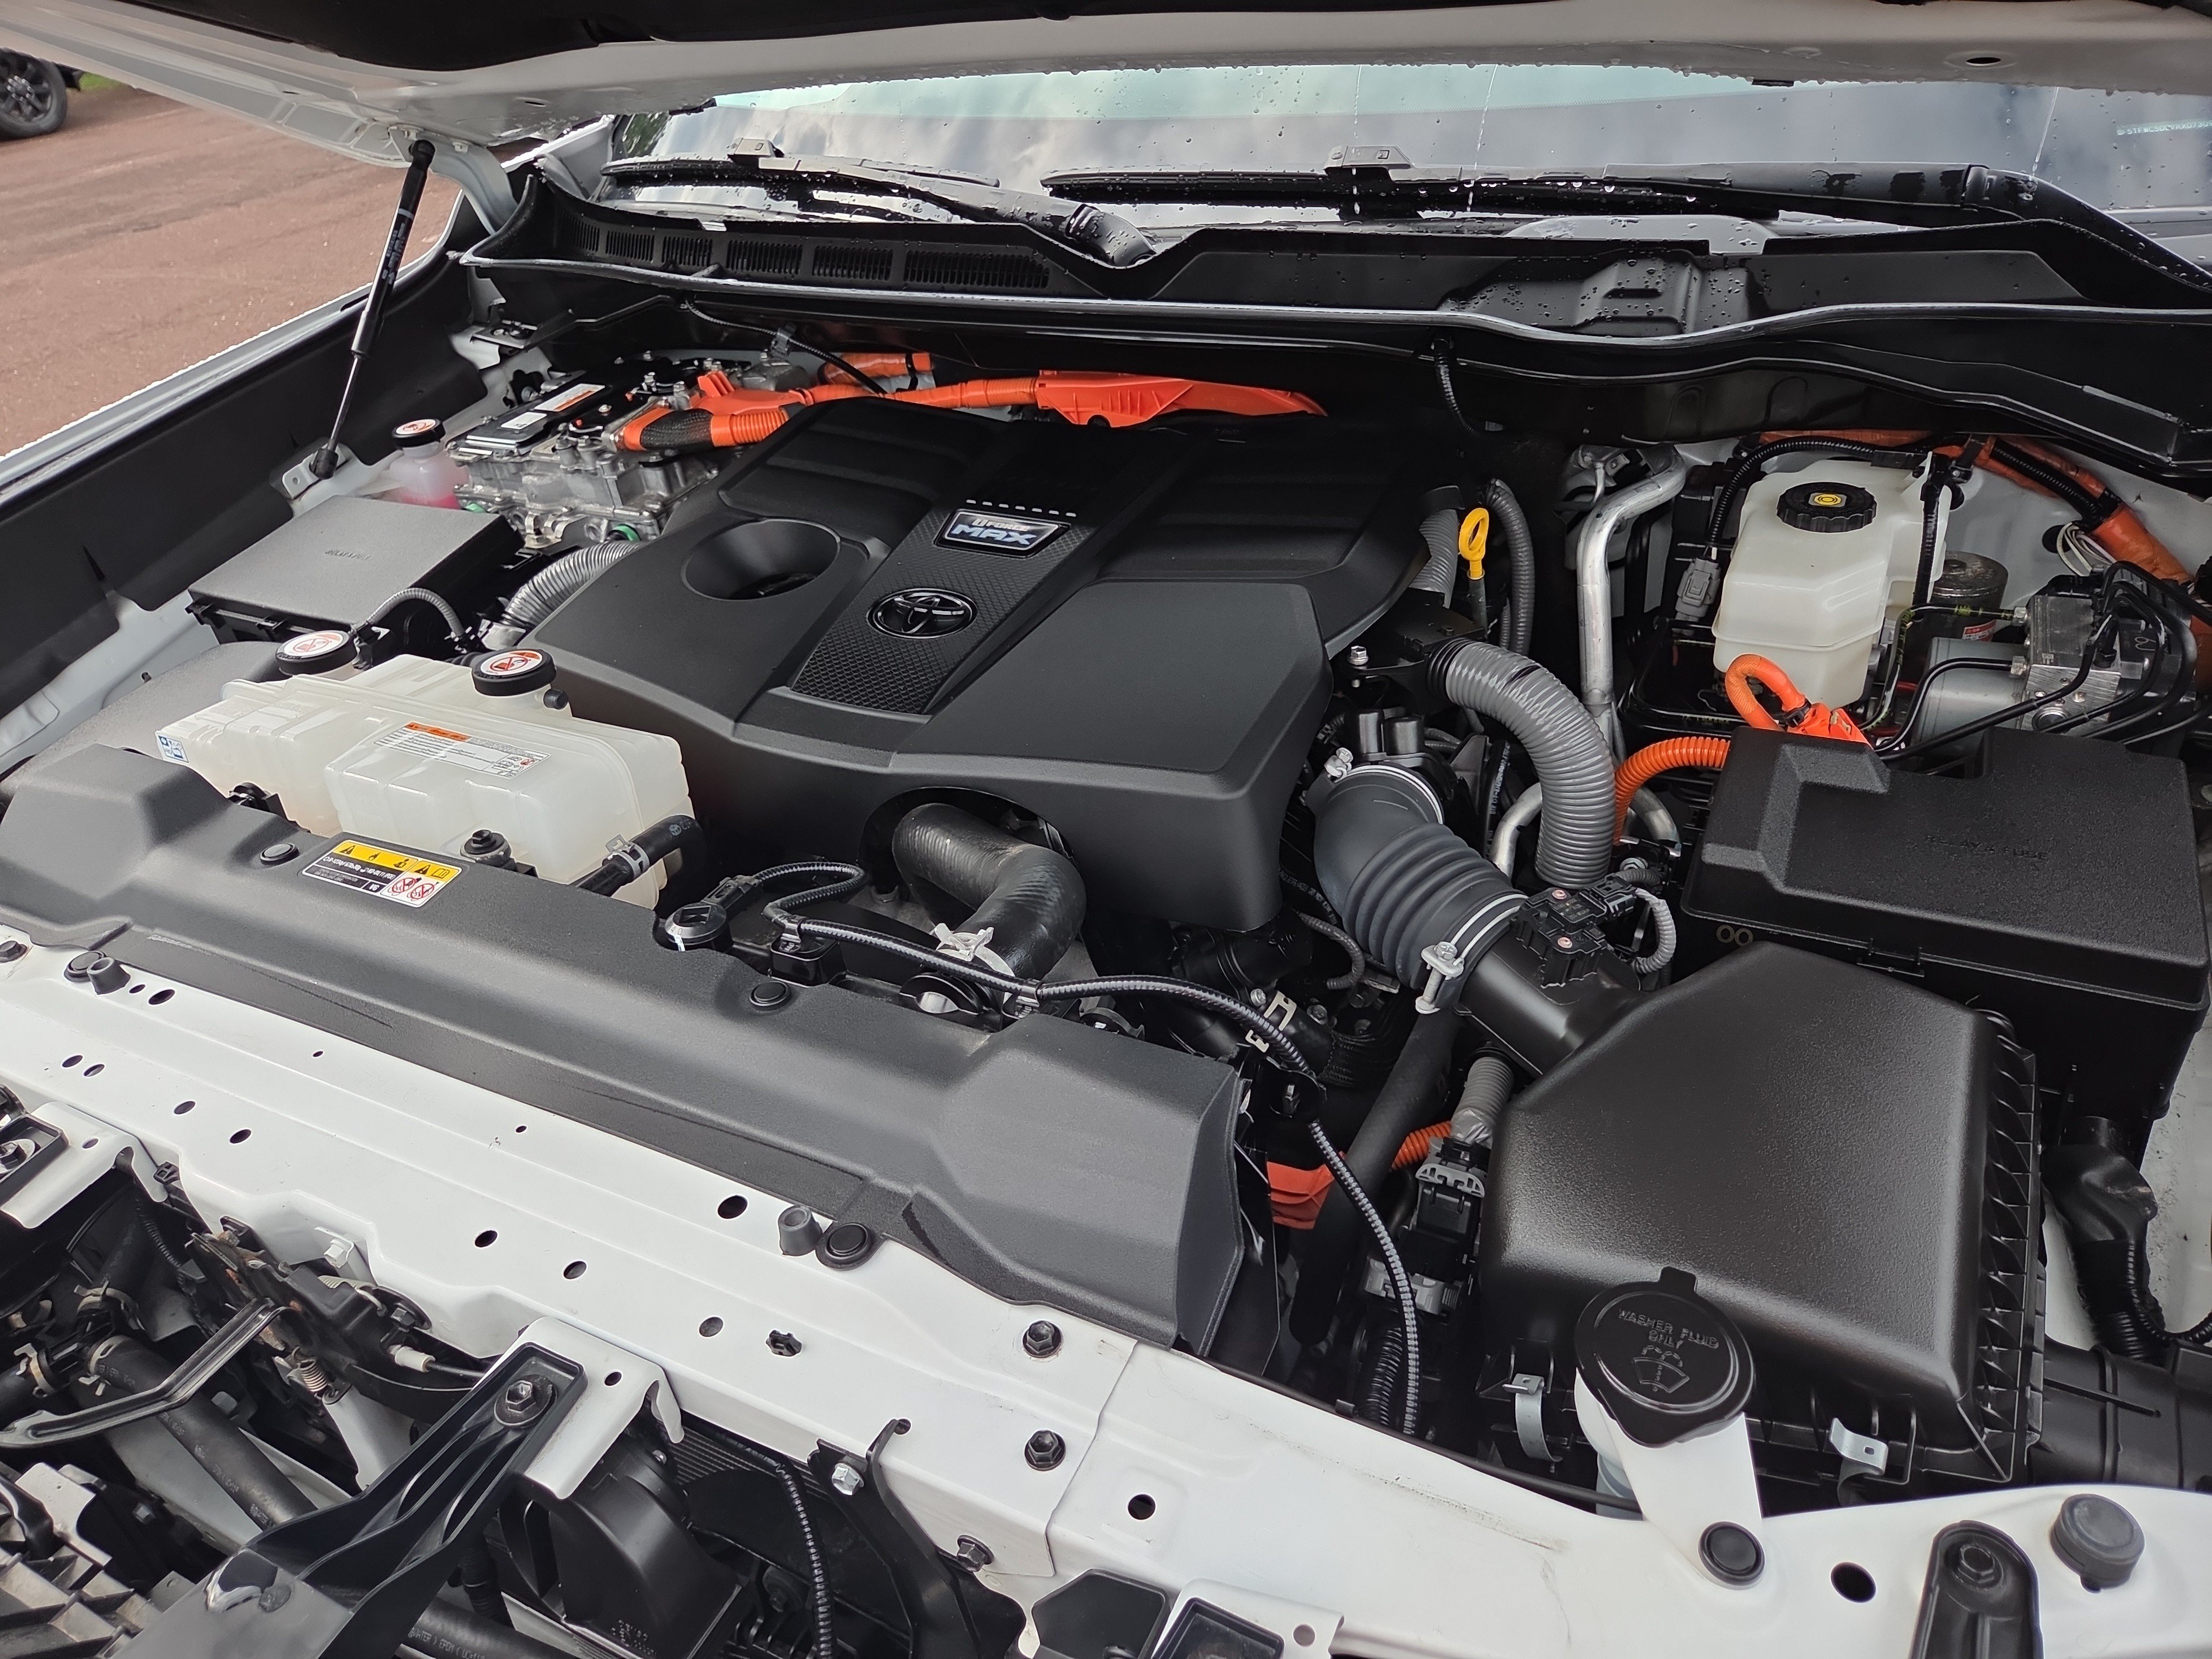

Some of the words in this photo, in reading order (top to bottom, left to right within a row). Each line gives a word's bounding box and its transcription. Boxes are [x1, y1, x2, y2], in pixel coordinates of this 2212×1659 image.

[951, 524, 1037, 545] MAX
[1618, 1309, 1673, 1335] WASHER
[1680, 1328, 1720, 1349] FLUID
[1648, 1330, 1684, 1349] ONLY
